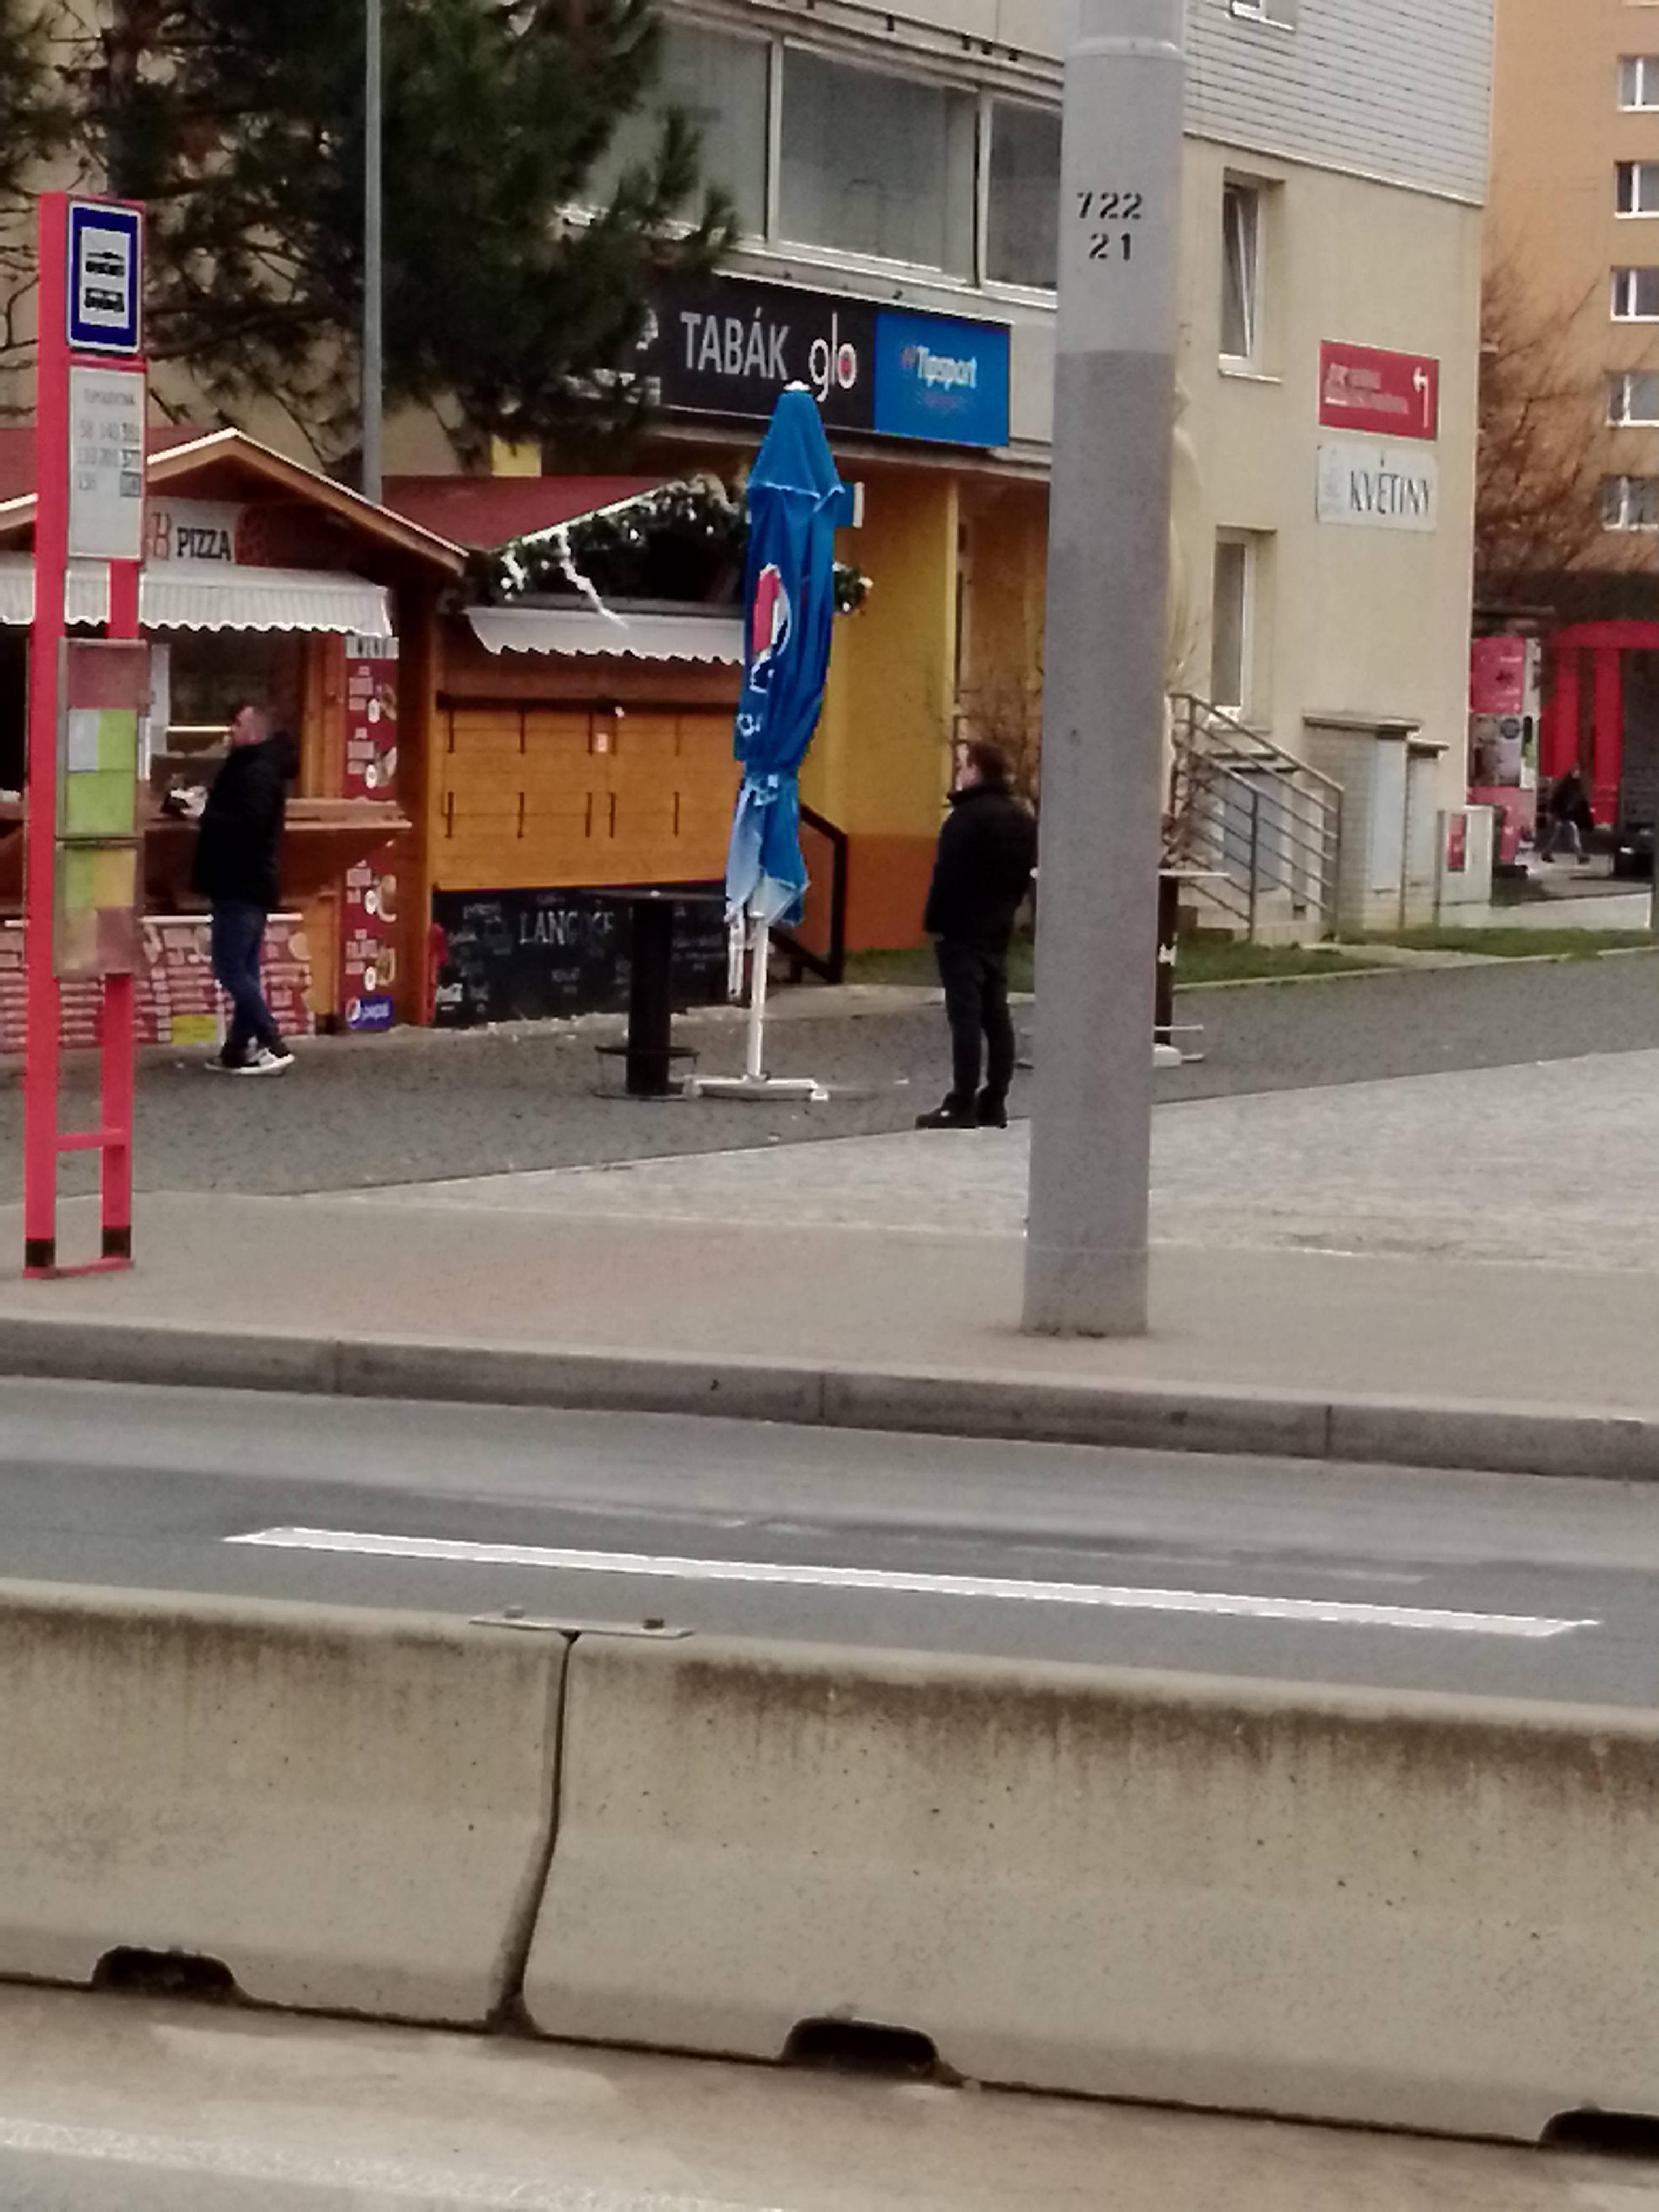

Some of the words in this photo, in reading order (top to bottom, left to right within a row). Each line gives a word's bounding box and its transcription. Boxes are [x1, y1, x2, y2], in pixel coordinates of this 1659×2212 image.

[1077, 192, 1142, 219] 722
[1089, 233, 1131, 261] 21
[680, 306, 790, 380] TABÁK
[809, 310, 858, 402] glo
[177, 526, 231, 561] PIZZA
